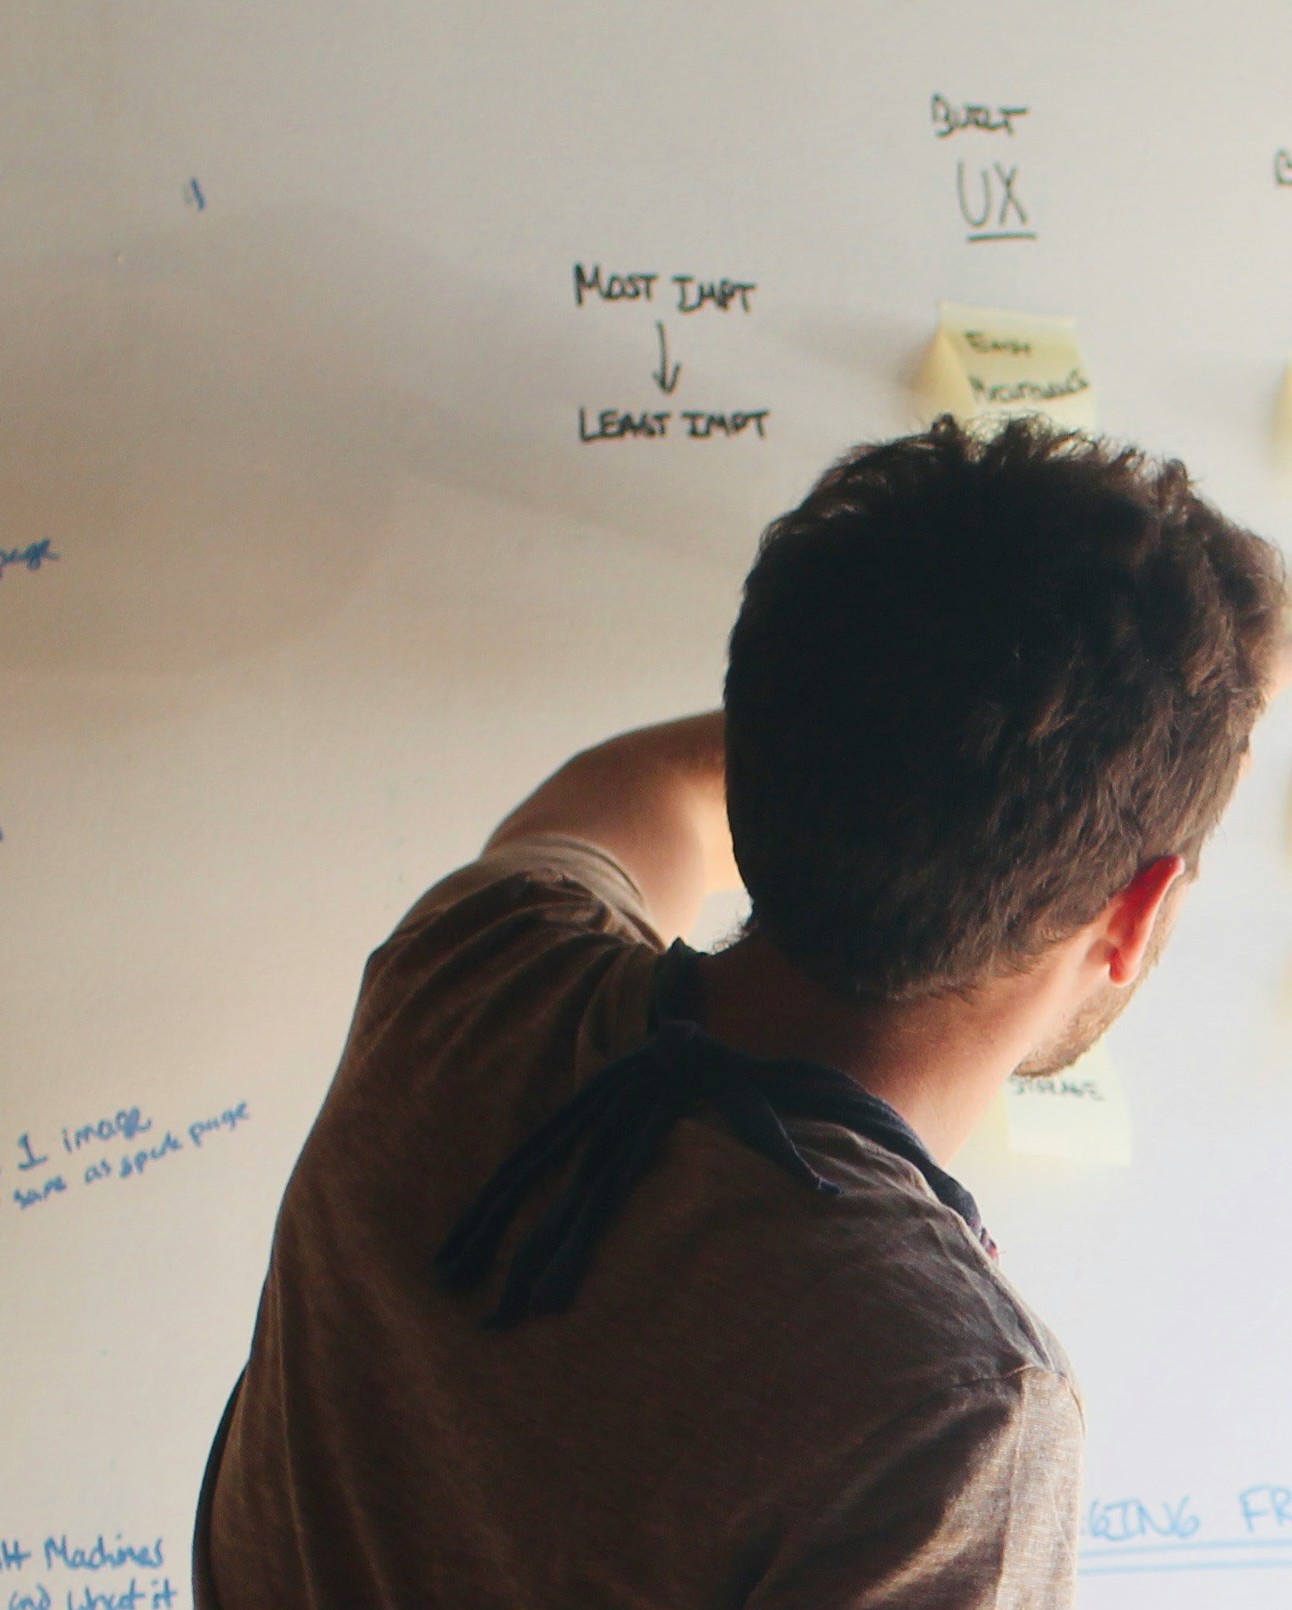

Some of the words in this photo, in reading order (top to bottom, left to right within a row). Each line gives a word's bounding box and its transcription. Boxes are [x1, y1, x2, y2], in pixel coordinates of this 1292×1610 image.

[956, 158, 1029, 229] UX
[573, 262, 659, 308] MOST
[579, 405, 671, 444] LEAST
[1088, 1495, 1201, 1542] GING
[43, 1532, 164, 1572] Machines
[151, 1576, 178, 1610] it
